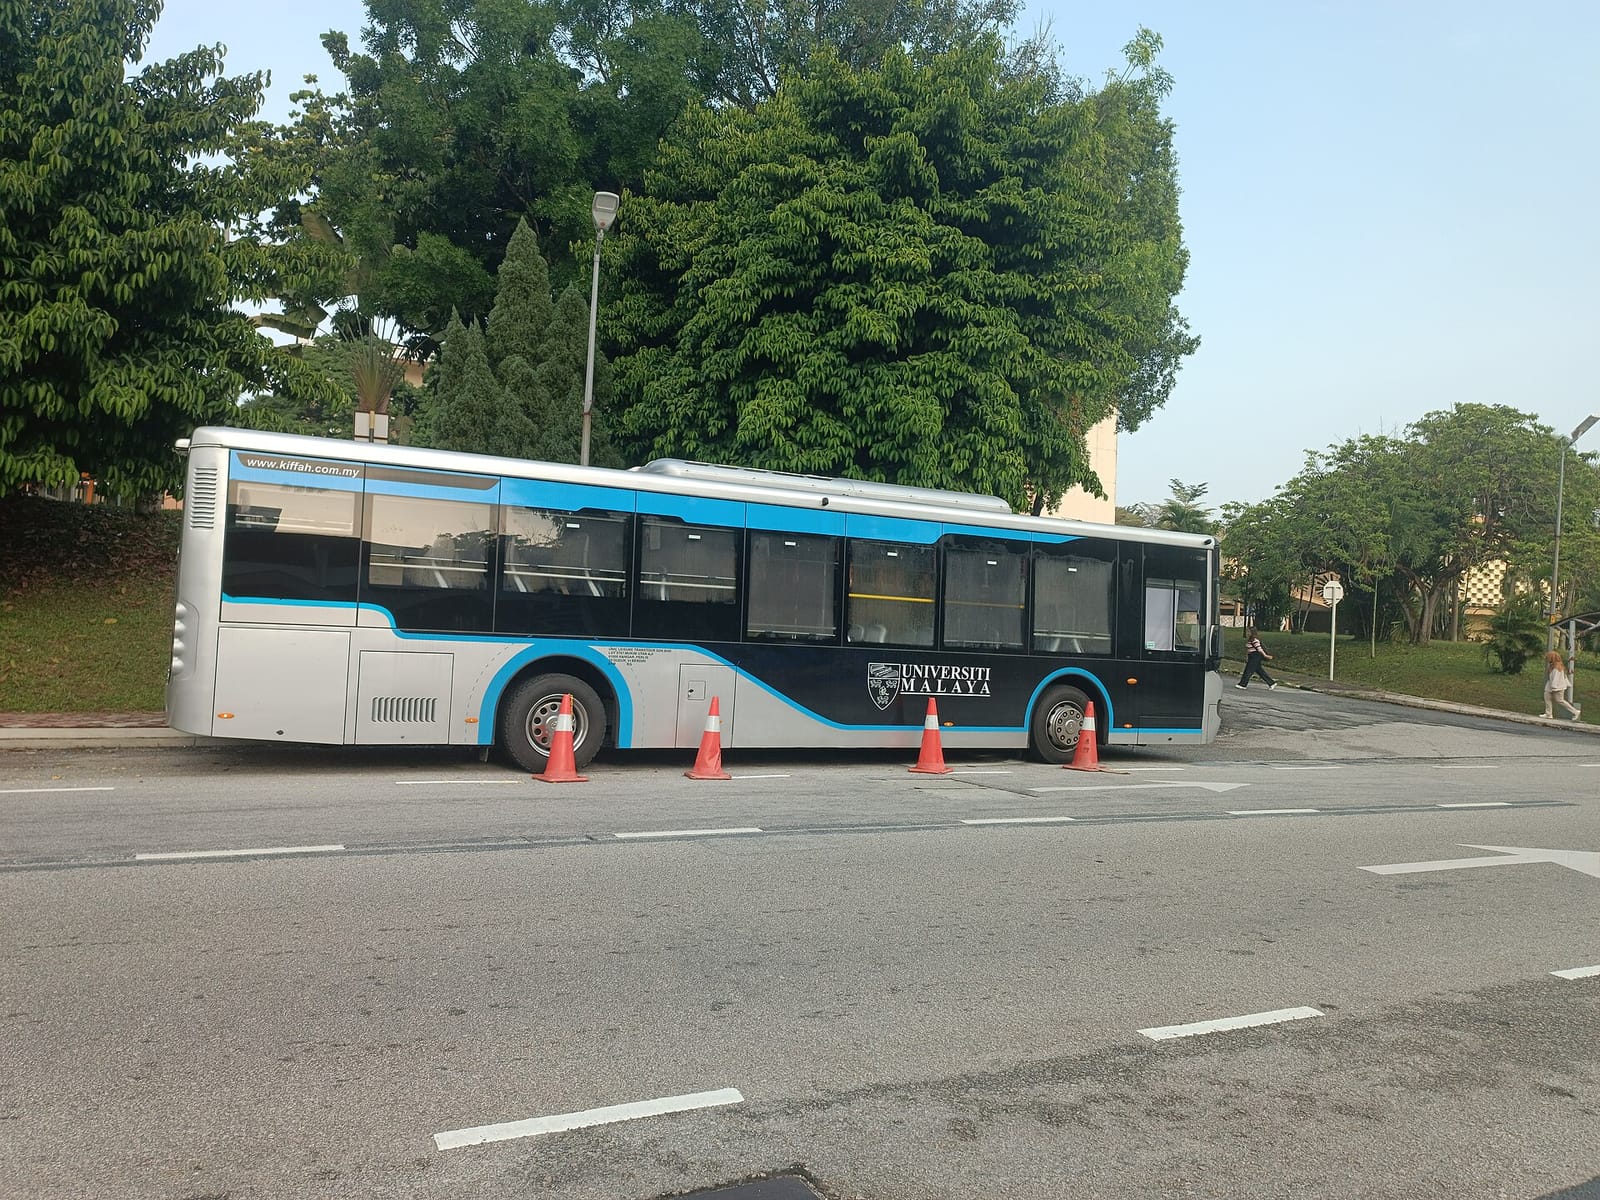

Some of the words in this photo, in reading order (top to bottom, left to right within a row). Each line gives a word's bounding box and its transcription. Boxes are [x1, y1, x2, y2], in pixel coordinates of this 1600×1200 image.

[247, 459, 359, 478] www.kiffah.com.my
[902, 664, 991, 681] UNIVERSITI
[900, 678, 990, 694] MALAYA
